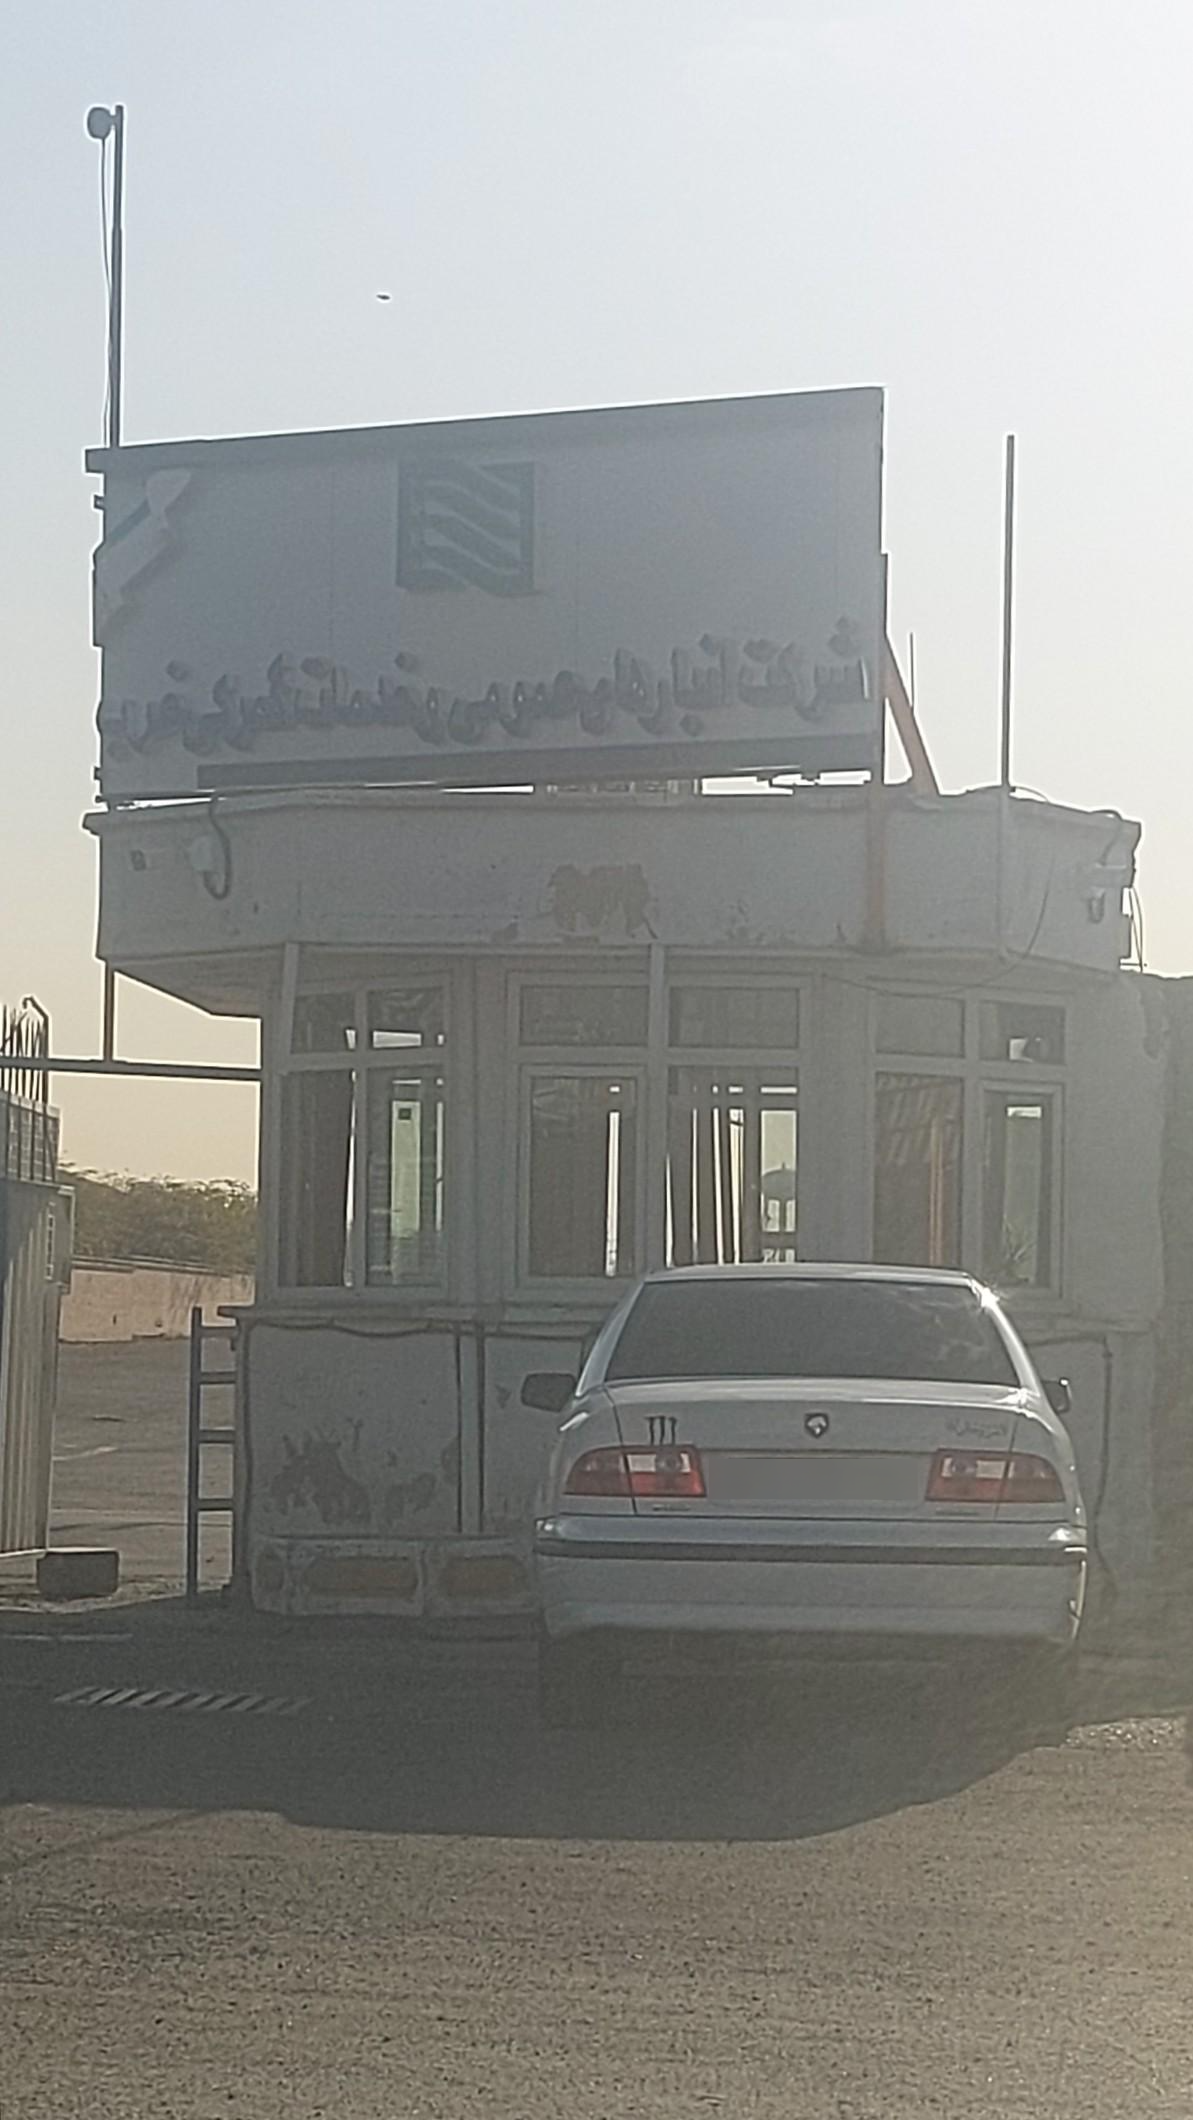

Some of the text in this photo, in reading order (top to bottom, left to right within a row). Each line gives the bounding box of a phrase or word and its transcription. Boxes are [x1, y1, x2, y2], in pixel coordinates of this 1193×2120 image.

[183, 650, 298, 757] گمرکی
[294, 650, 418, 729] خدمات
[447, 669, 584, 745] عمومی
[582, 633, 728, 737] انبارهای
[738, 615, 871, 724] شرکت
[414, 686, 447, 746] و
